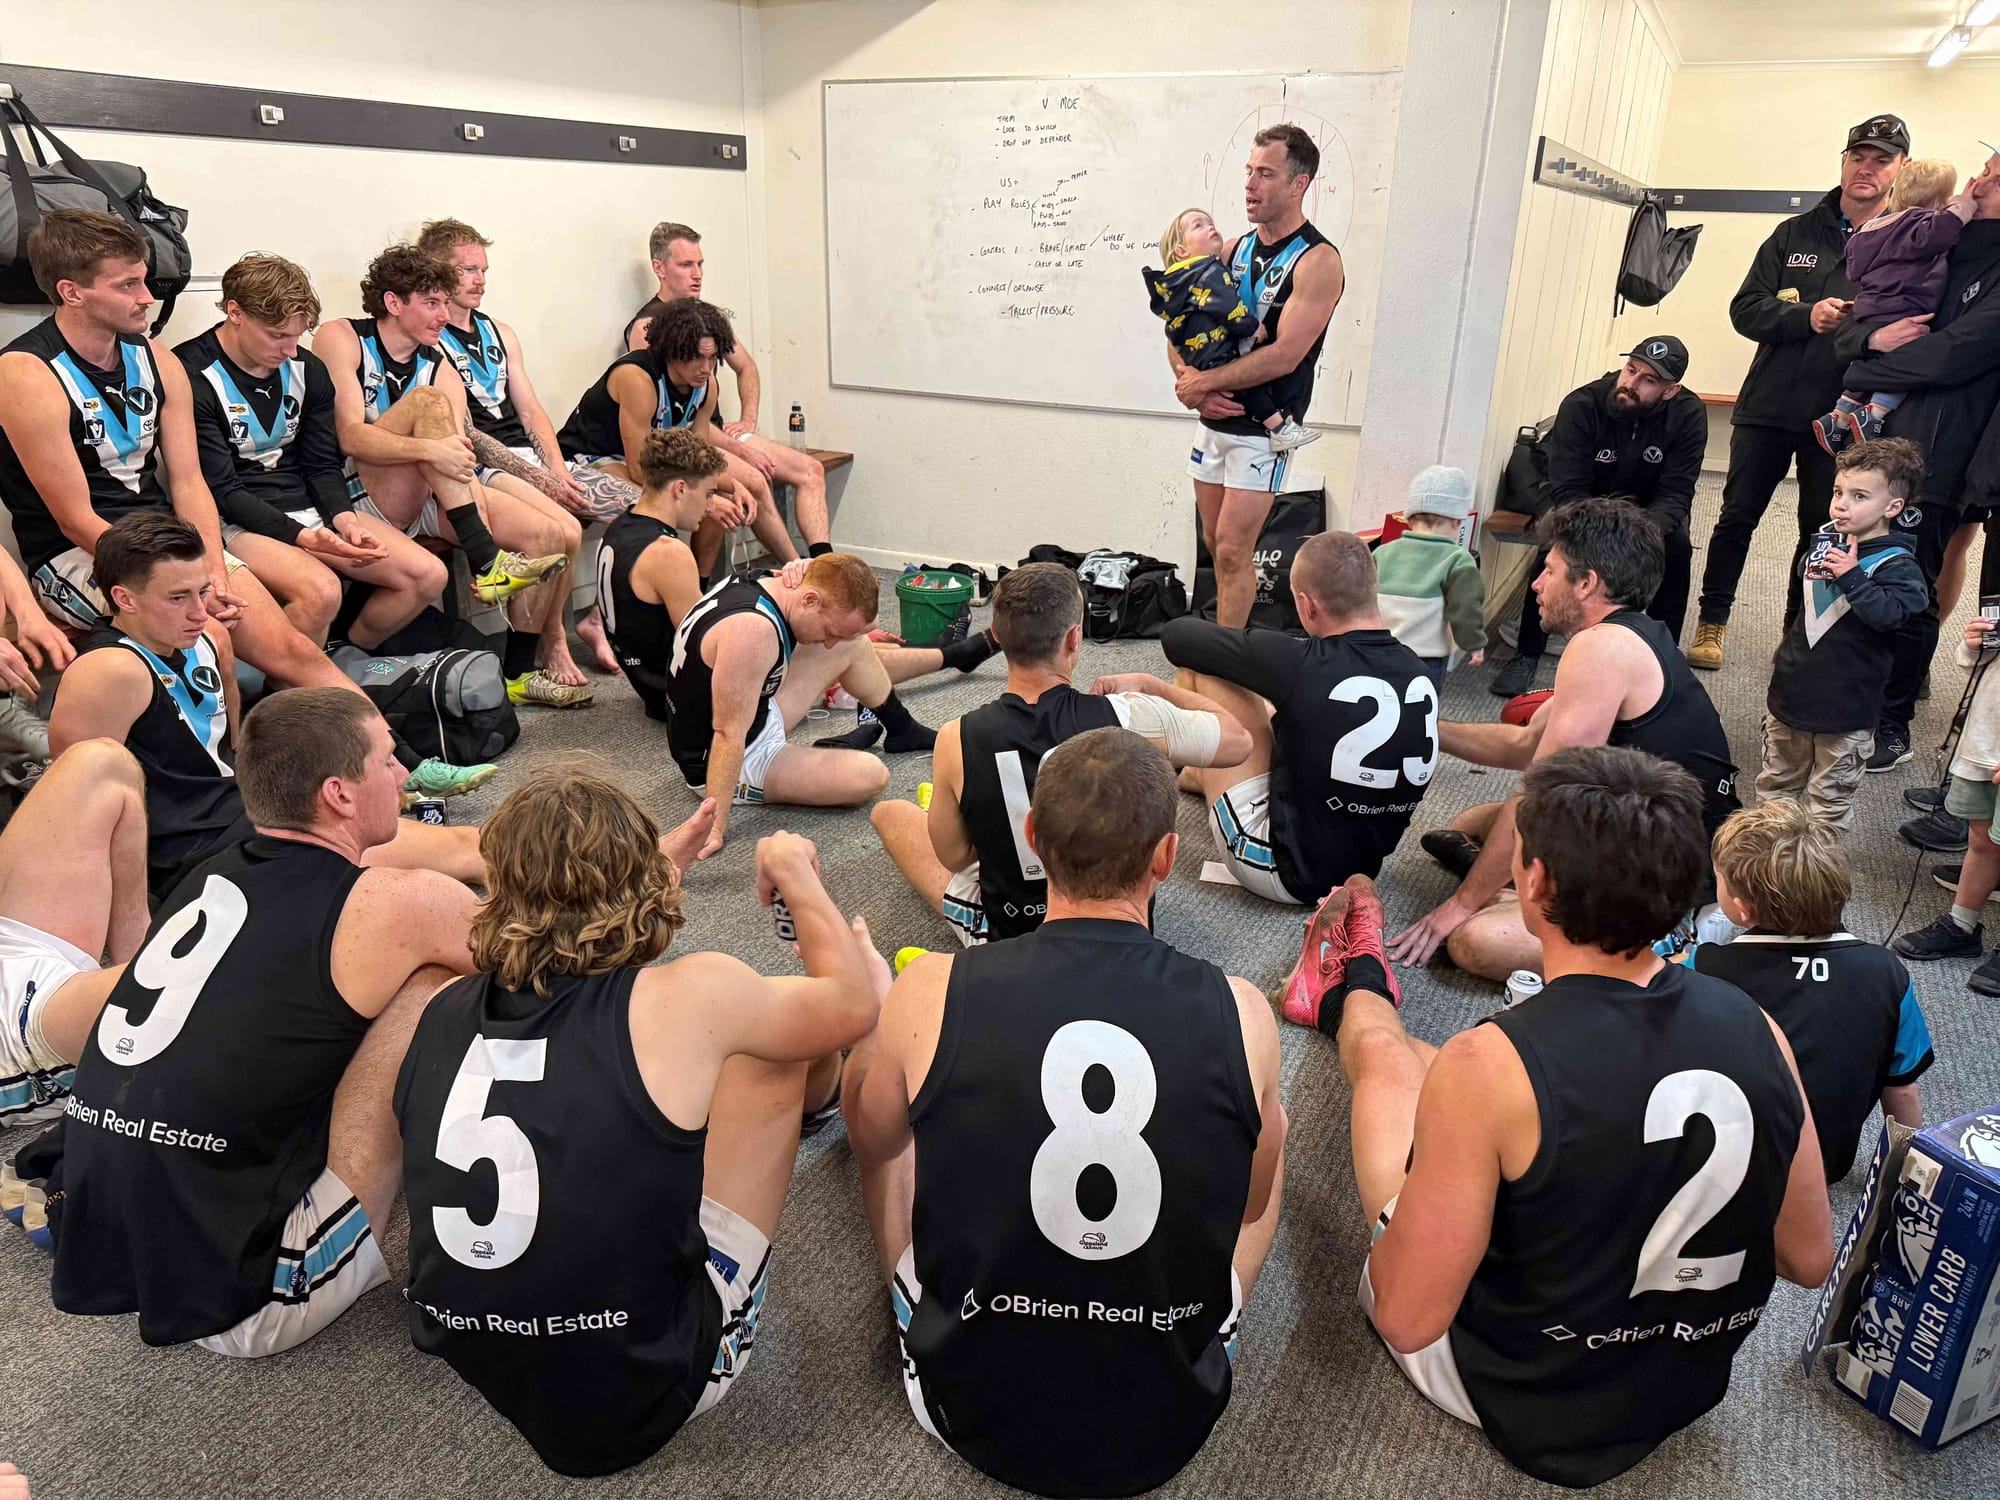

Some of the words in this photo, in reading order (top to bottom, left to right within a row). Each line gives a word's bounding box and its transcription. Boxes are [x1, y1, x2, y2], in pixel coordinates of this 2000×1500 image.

[1042, 97, 1049, 109] V
[1060, 96, 1080, 109] MOE
[1002, 139, 1016, 147] DROP
[1040, 134, 1073, 145] DEFENDER
[983, 198, 1001, 209] PLAY
[1011, 200, 1030, 210] ROLES
[980, 246, 1006, 256] CONTROL
[1103, 233, 1125, 242] WHERE
[1068, 259, 1083, 268] LATE
[624, 657, 641, 667] ate
[1328, 675, 1439, 789] 23
[994, 745, 1062, 881] 1
[1348, 802, 1384, 815] OBrien
[1386, 803, 1407, 813] Real
[98, 874, 248, 1066] 9
[1791, 956, 1829, 982] 70
[64, 1093, 98, 1126] Brien
[102, 1109, 146, 1138] Real
[149, 1121, 228, 1152] Estate
[1030, 1020, 1162, 1261] 8
[432, 1033, 548, 1269] 5
[1629, 1069, 1754, 1300] 2
[1807, 1221, 1857, 1351] CARLTON
[1858, 1141, 1881, 1224] DRY
[991, 1294, 1079, 1320] OBrien
[1088, 1301, 1144, 1323] Real
[1152, 1302, 1203, 1331] Estate
[1861, 1296, 1905, 1339] RY
[1891, 1294, 1911, 1310] ARB
[1906, 1302, 1949, 1374] LOWER
[1929, 1247, 1967, 1304] CARB
[486, 1314, 539, 1336] Real
[547, 1309, 629, 1336] Estate
[1586, 1323, 1665, 1349] OBrien
[1673, 1317, 1723, 1342] Real
[1727, 1305, 1765, 1331] Esta
